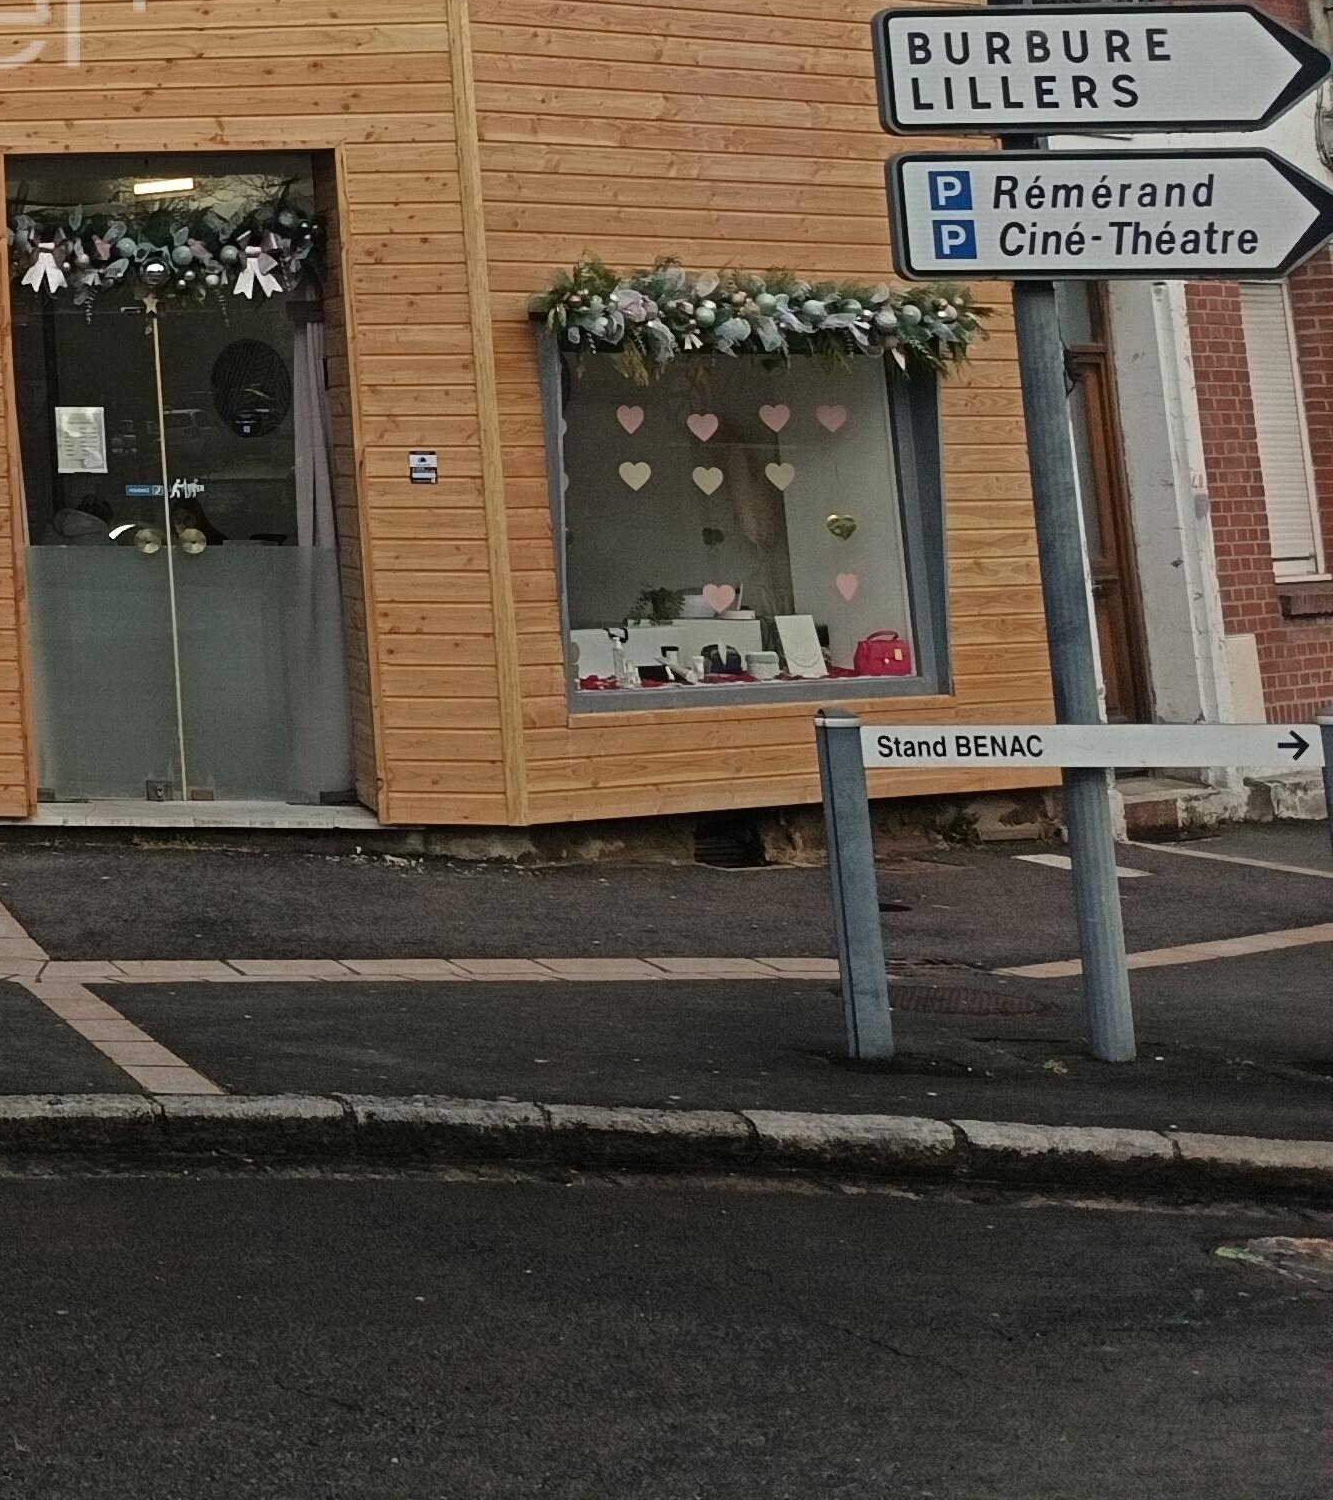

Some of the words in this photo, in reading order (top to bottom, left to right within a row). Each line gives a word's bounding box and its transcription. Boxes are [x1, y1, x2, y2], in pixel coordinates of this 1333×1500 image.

[907, 28, 1171, 65] BURBURE
[911, 74, 1139, 110] LILLERS
[936, 176, 962, 206] P
[993, 174, 1215, 209] Rémérand
[941, 224, 967, 255] P
[999, 221, 1259, 256] Ciné-Théatre
[877, 734, 947, 758] Stand
[955, 734, 1044, 758] BENAC
